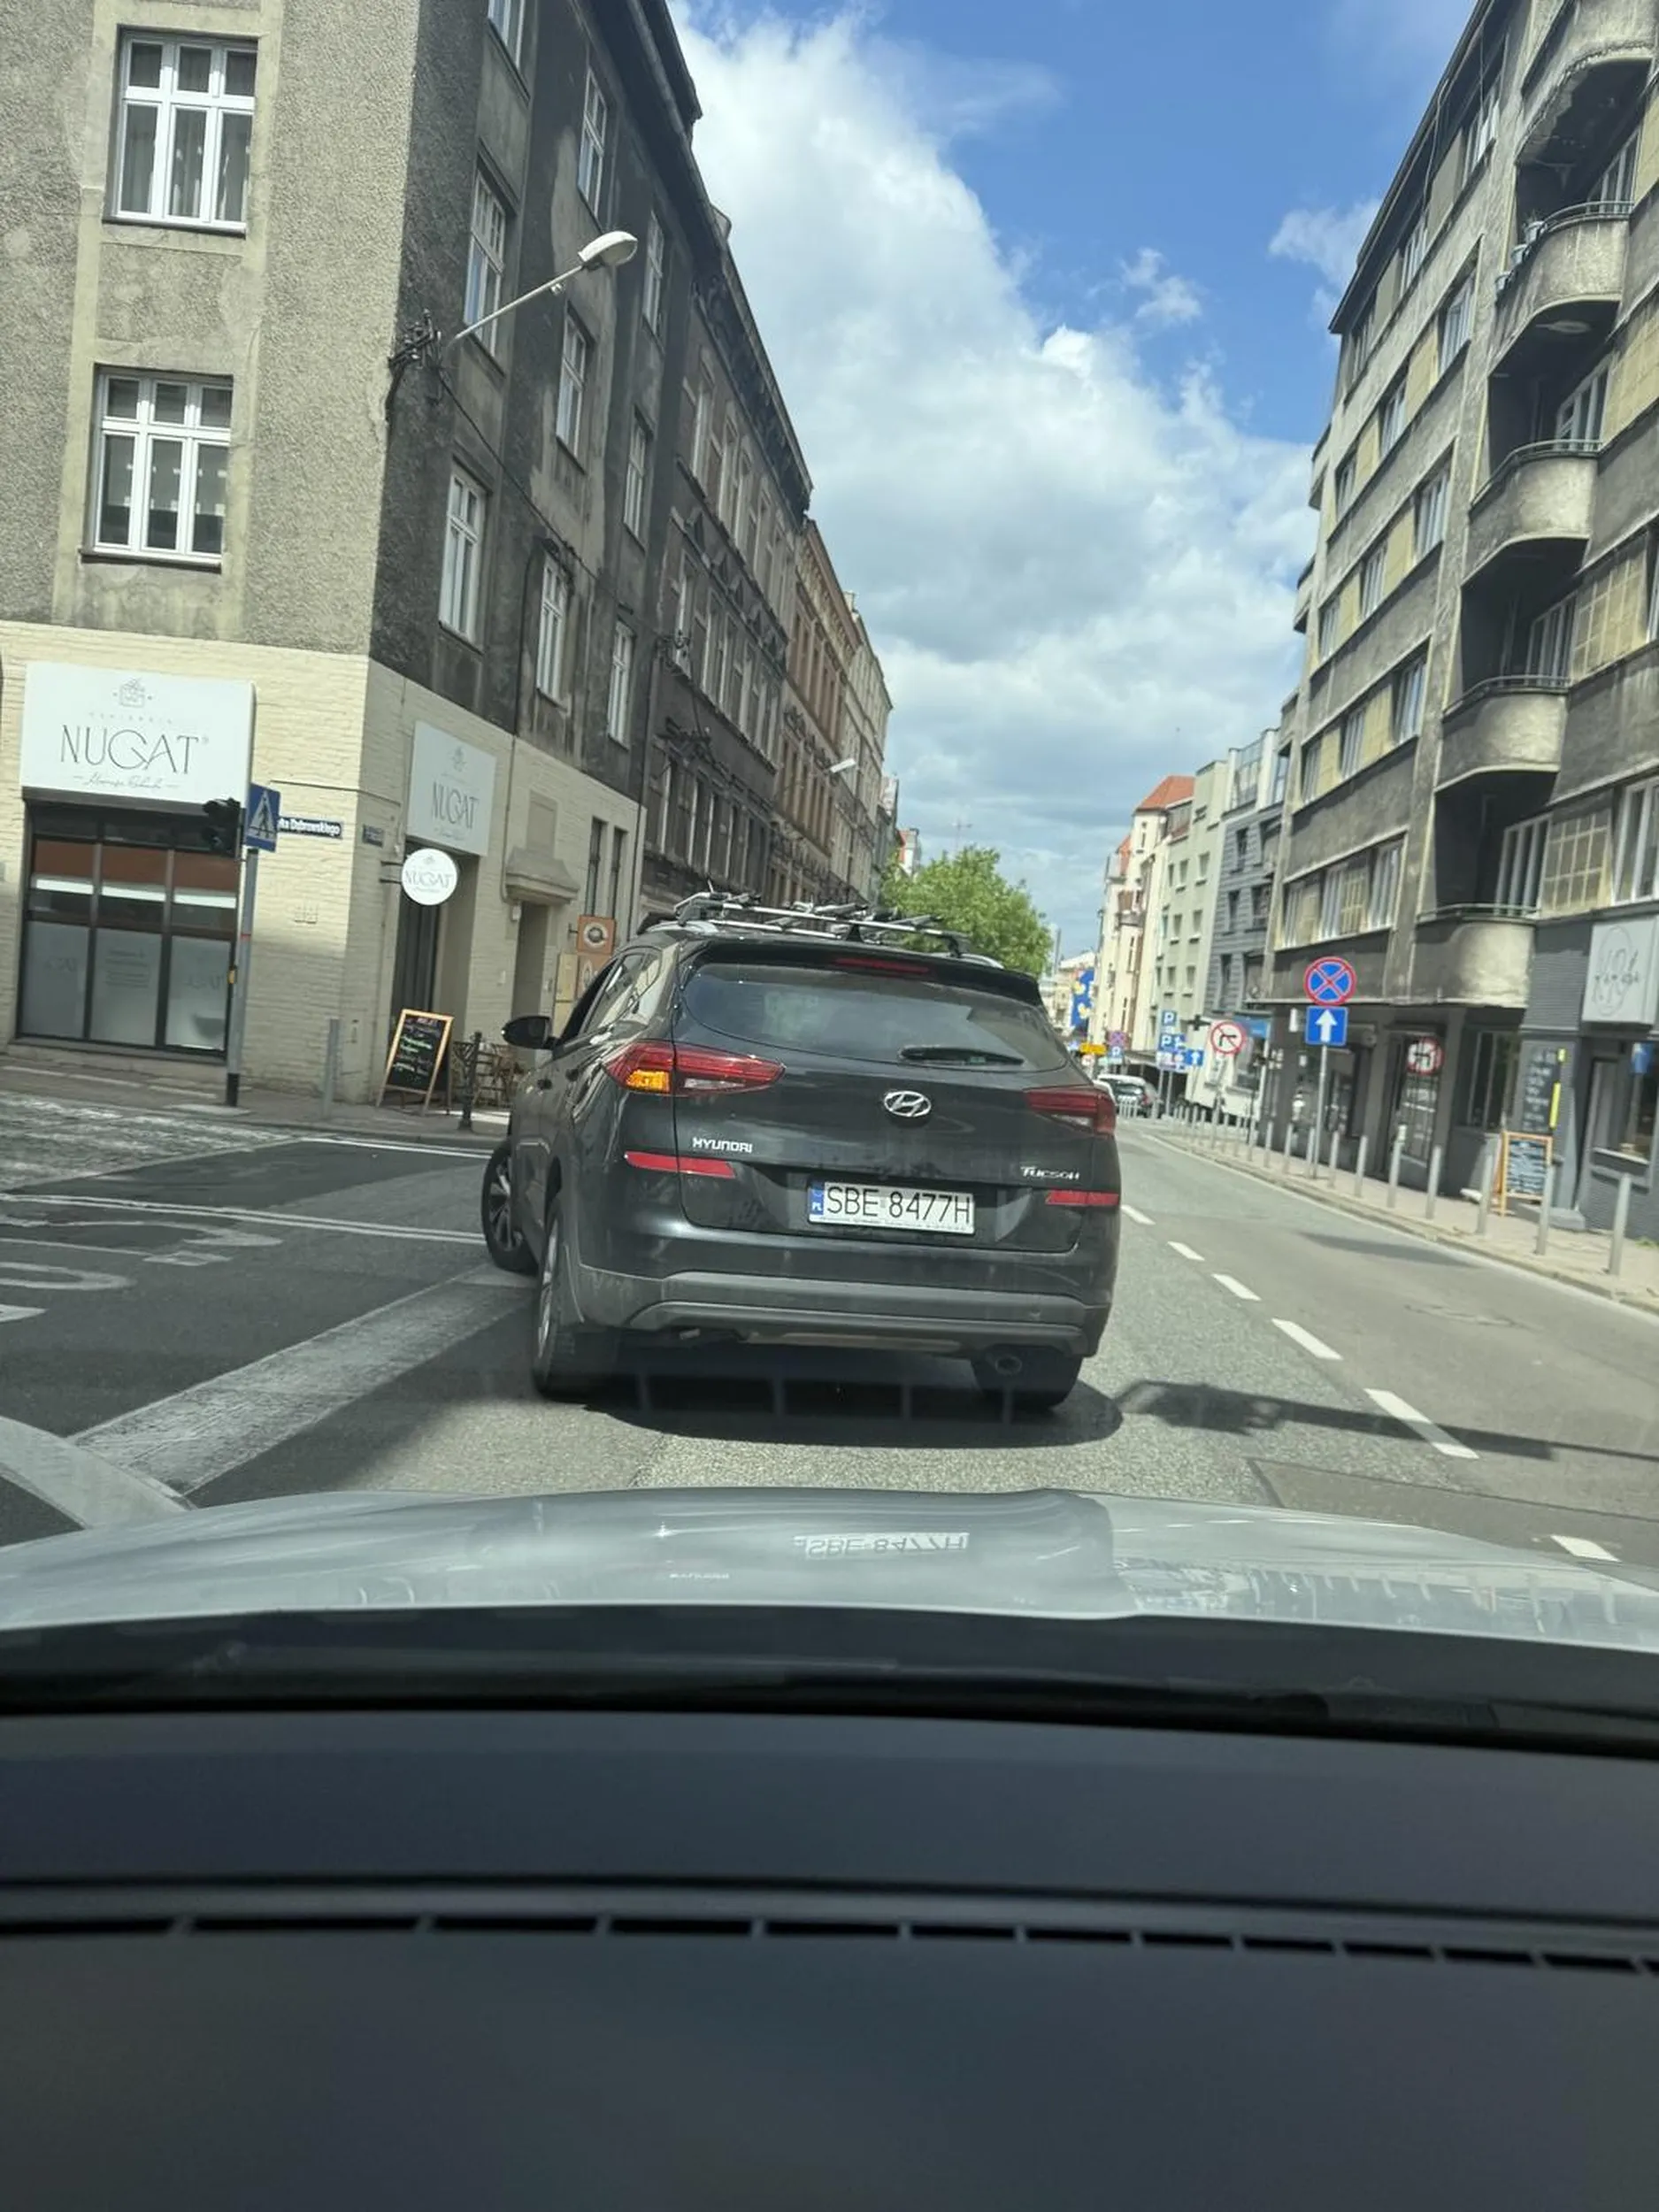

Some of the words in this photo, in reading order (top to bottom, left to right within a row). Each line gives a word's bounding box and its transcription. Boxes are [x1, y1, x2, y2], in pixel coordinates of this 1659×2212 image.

[60, 724, 199, 774] NUGAT
[431, 781, 479, 828] NUGAT
[405, 871, 454, 888] NUGAT
[693, 1136, 753, 1153] HYUNDAI
[826, 1186, 879, 1217] SBE
[889, 1191, 970, 1224] 8477H
